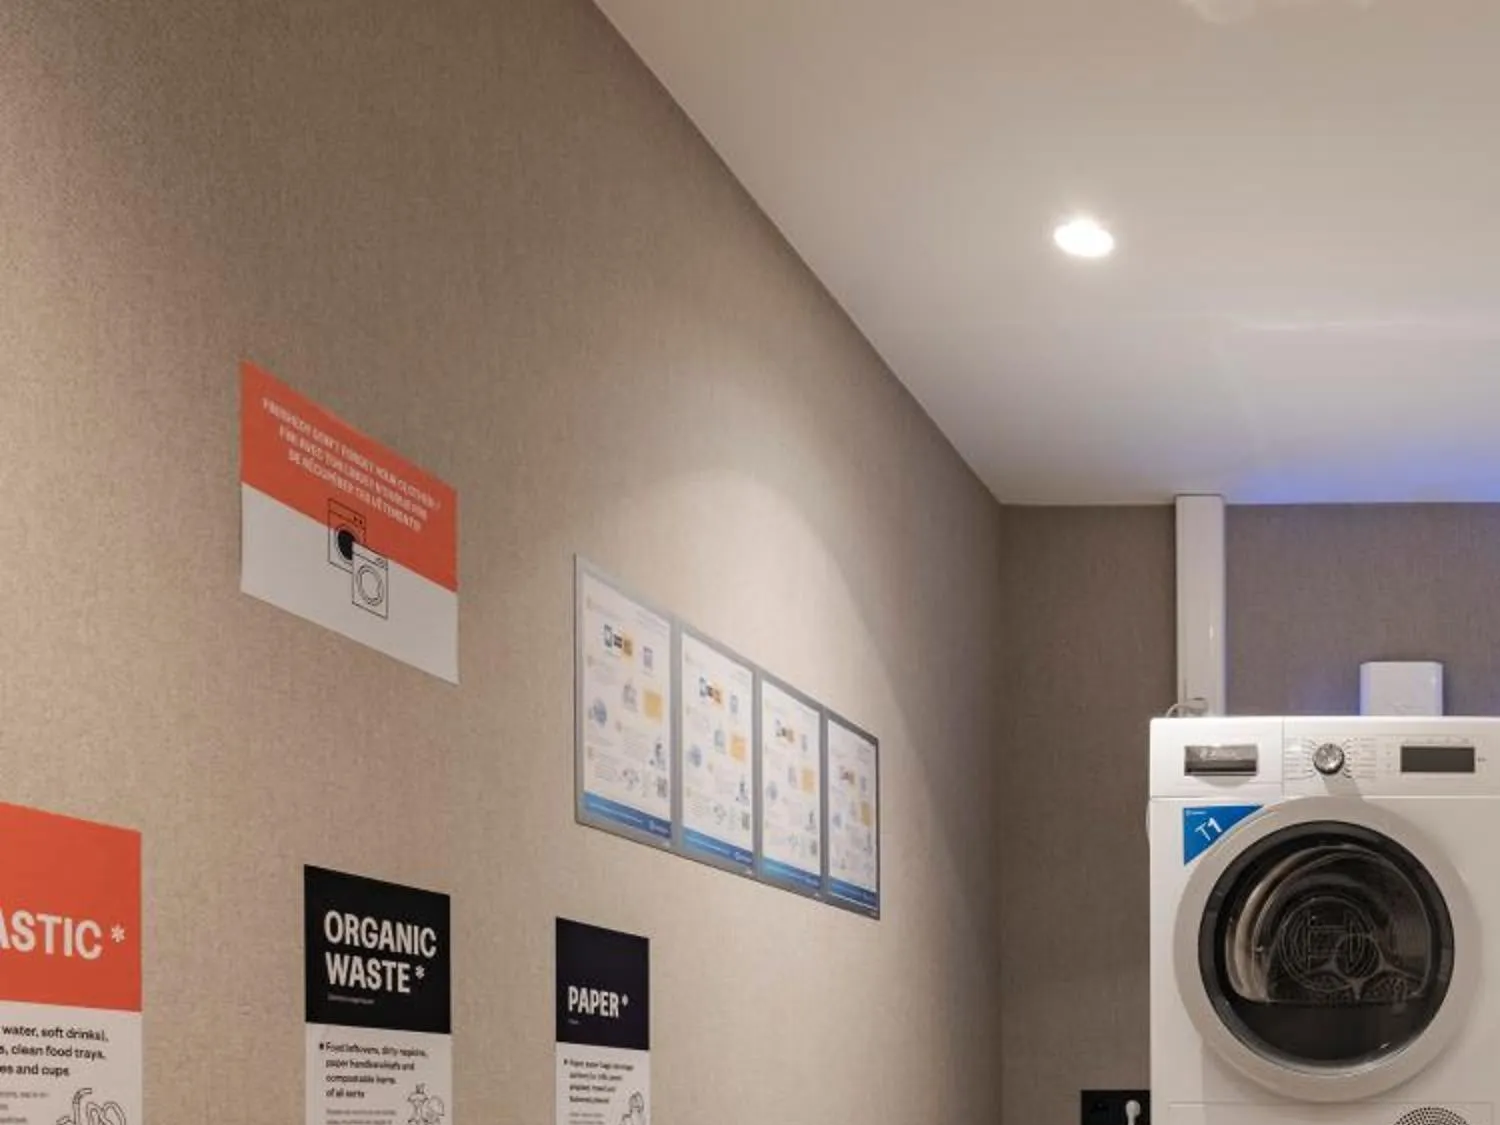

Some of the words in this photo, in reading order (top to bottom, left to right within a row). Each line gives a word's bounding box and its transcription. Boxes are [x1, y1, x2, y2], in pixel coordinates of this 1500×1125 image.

[1194, 817, 1222, 841] T1
[324, 909, 437, 958] ORGANIC
[41, 1027, 63, 1039] soft
[11, 1045, 43, 1056] clean
[46, 1046, 72, 1057] food
[16, 1064, 39, 1075] and
[41, 1066, 70, 1078] cups
